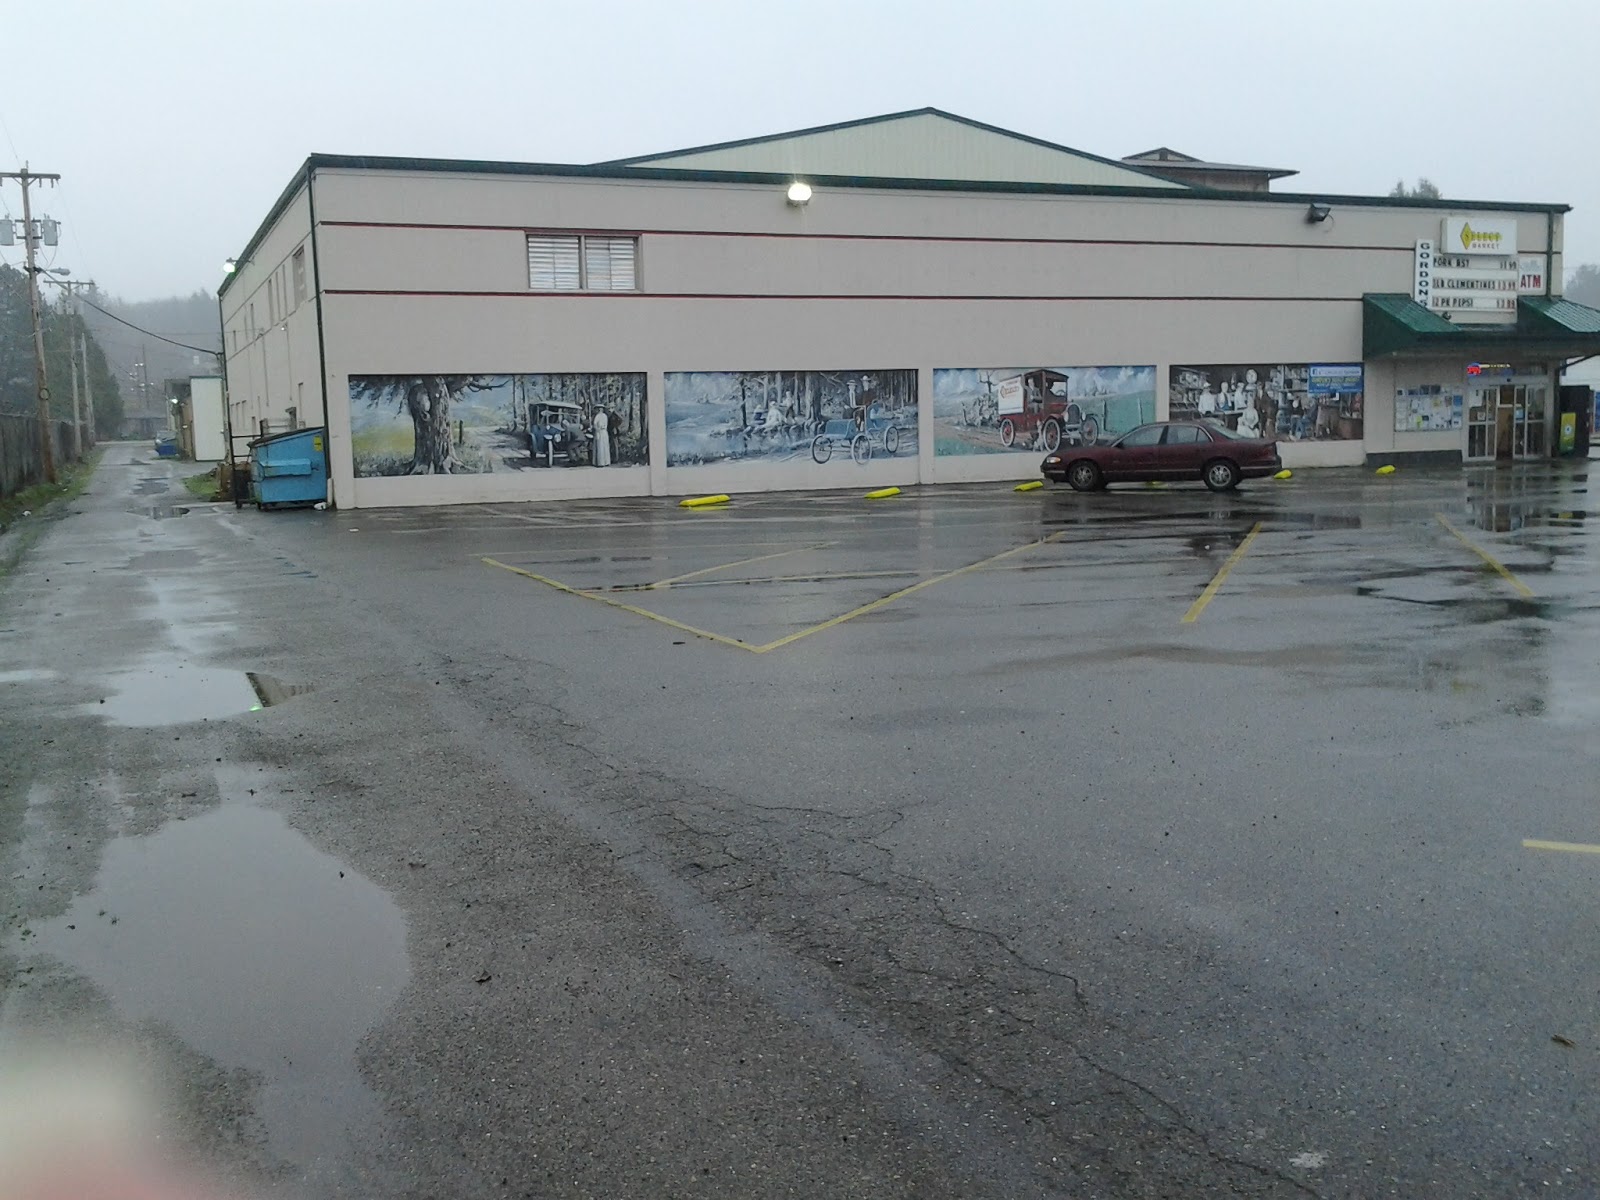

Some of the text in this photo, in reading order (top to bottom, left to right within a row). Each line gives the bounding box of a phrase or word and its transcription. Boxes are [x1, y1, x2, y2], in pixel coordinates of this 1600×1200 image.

[1433, 256, 1451, 267] PORK
[1447, 279, 1495, 289] CLEMENTINES
[1521, 275, 1541, 288] ATM
[1441, 298, 1450, 307] PK
[1453, 298, 1473, 307] PEPSI
